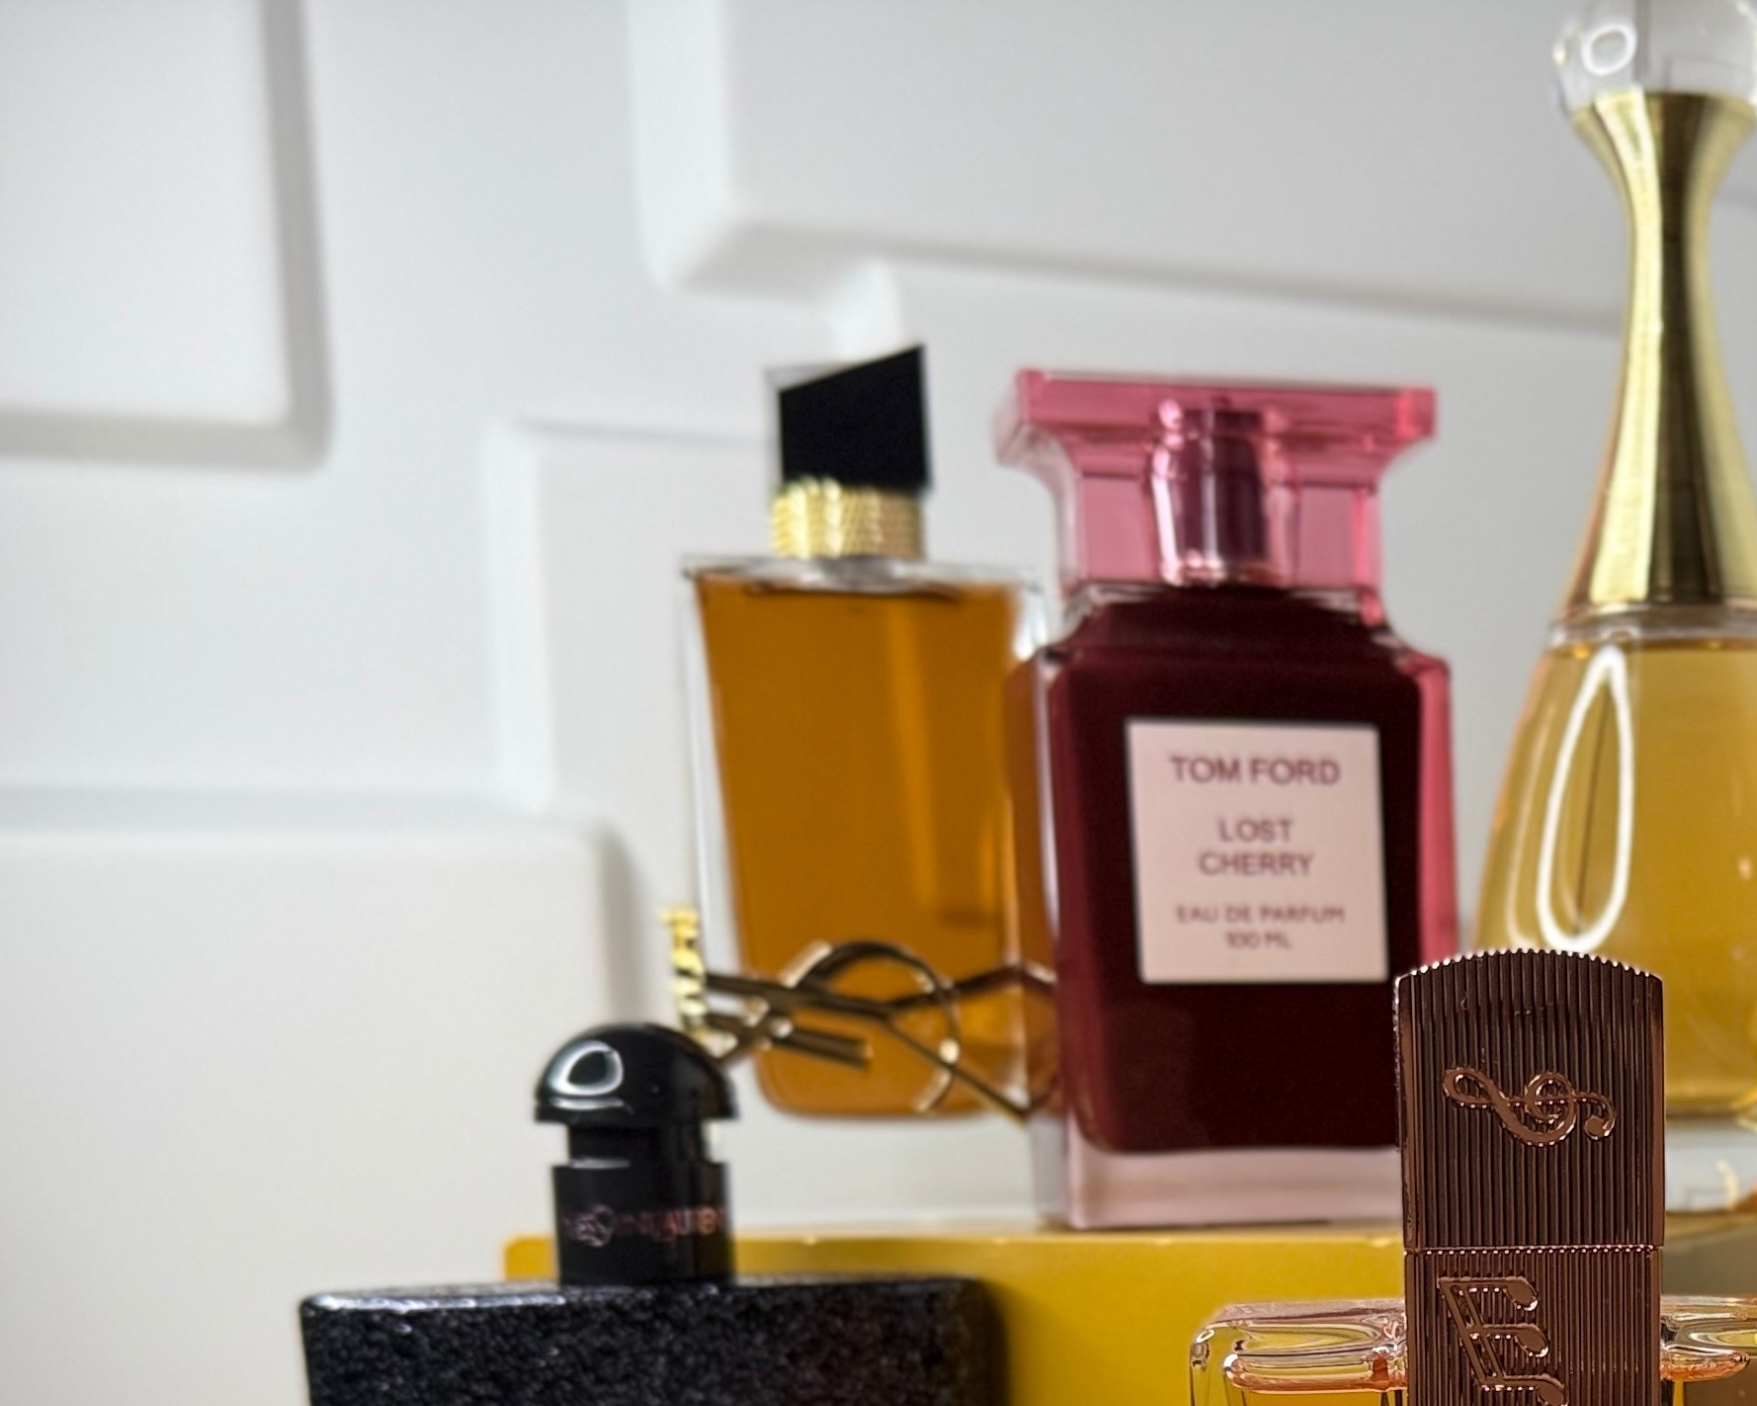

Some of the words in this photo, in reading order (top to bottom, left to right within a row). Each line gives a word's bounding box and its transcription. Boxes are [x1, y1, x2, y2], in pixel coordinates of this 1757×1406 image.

[1169, 755, 1241, 784] TOM
[1251, 757, 1341, 785] FORD
[1218, 818, 1293, 843] LOST
[1198, 852, 1314, 876] CHERRY
[1176, 906, 1218, 924] EAU
[1224, 906, 1253, 924] DE
[1259, 906, 1344, 924] PARFUM
